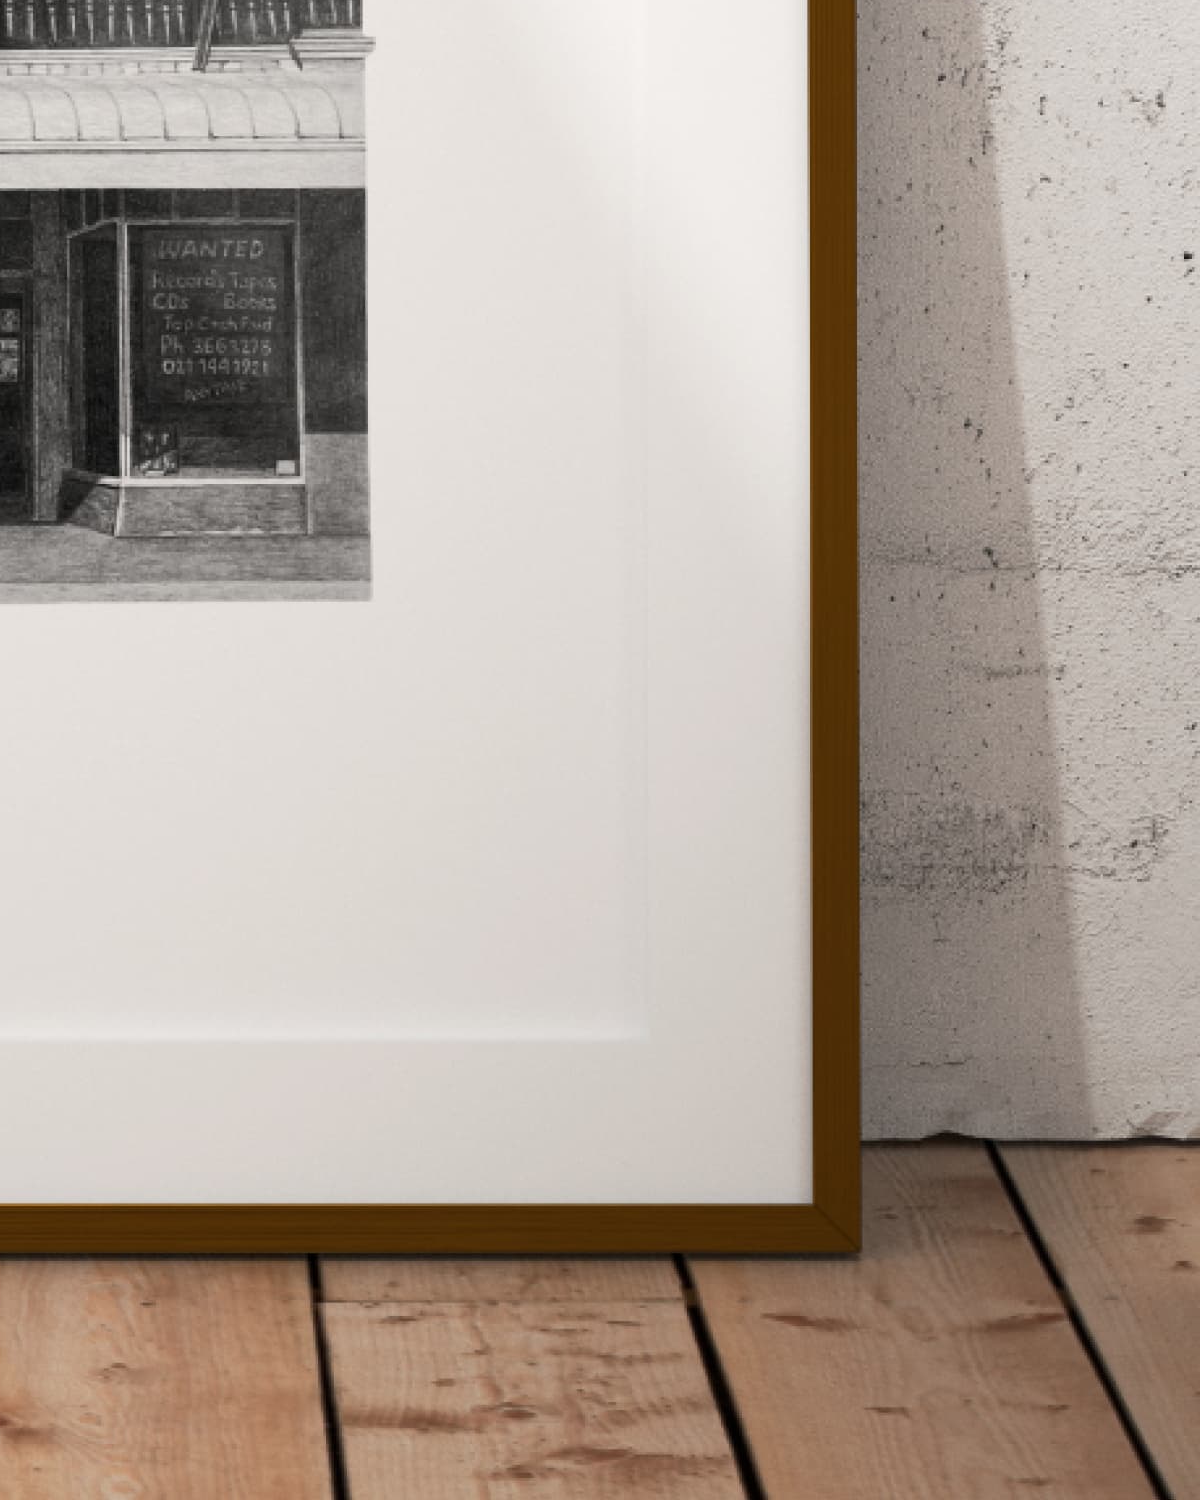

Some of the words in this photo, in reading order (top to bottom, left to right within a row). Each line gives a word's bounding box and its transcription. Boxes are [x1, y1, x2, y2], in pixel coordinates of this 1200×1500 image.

[158, 239, 264, 260] WANTED
[229, 271, 277, 293] Tapes
[152, 292, 190, 309] CDs
[223, 292, 277, 310] Books
[163, 314, 194, 335] Top
[161, 334, 184, 356] Ph
